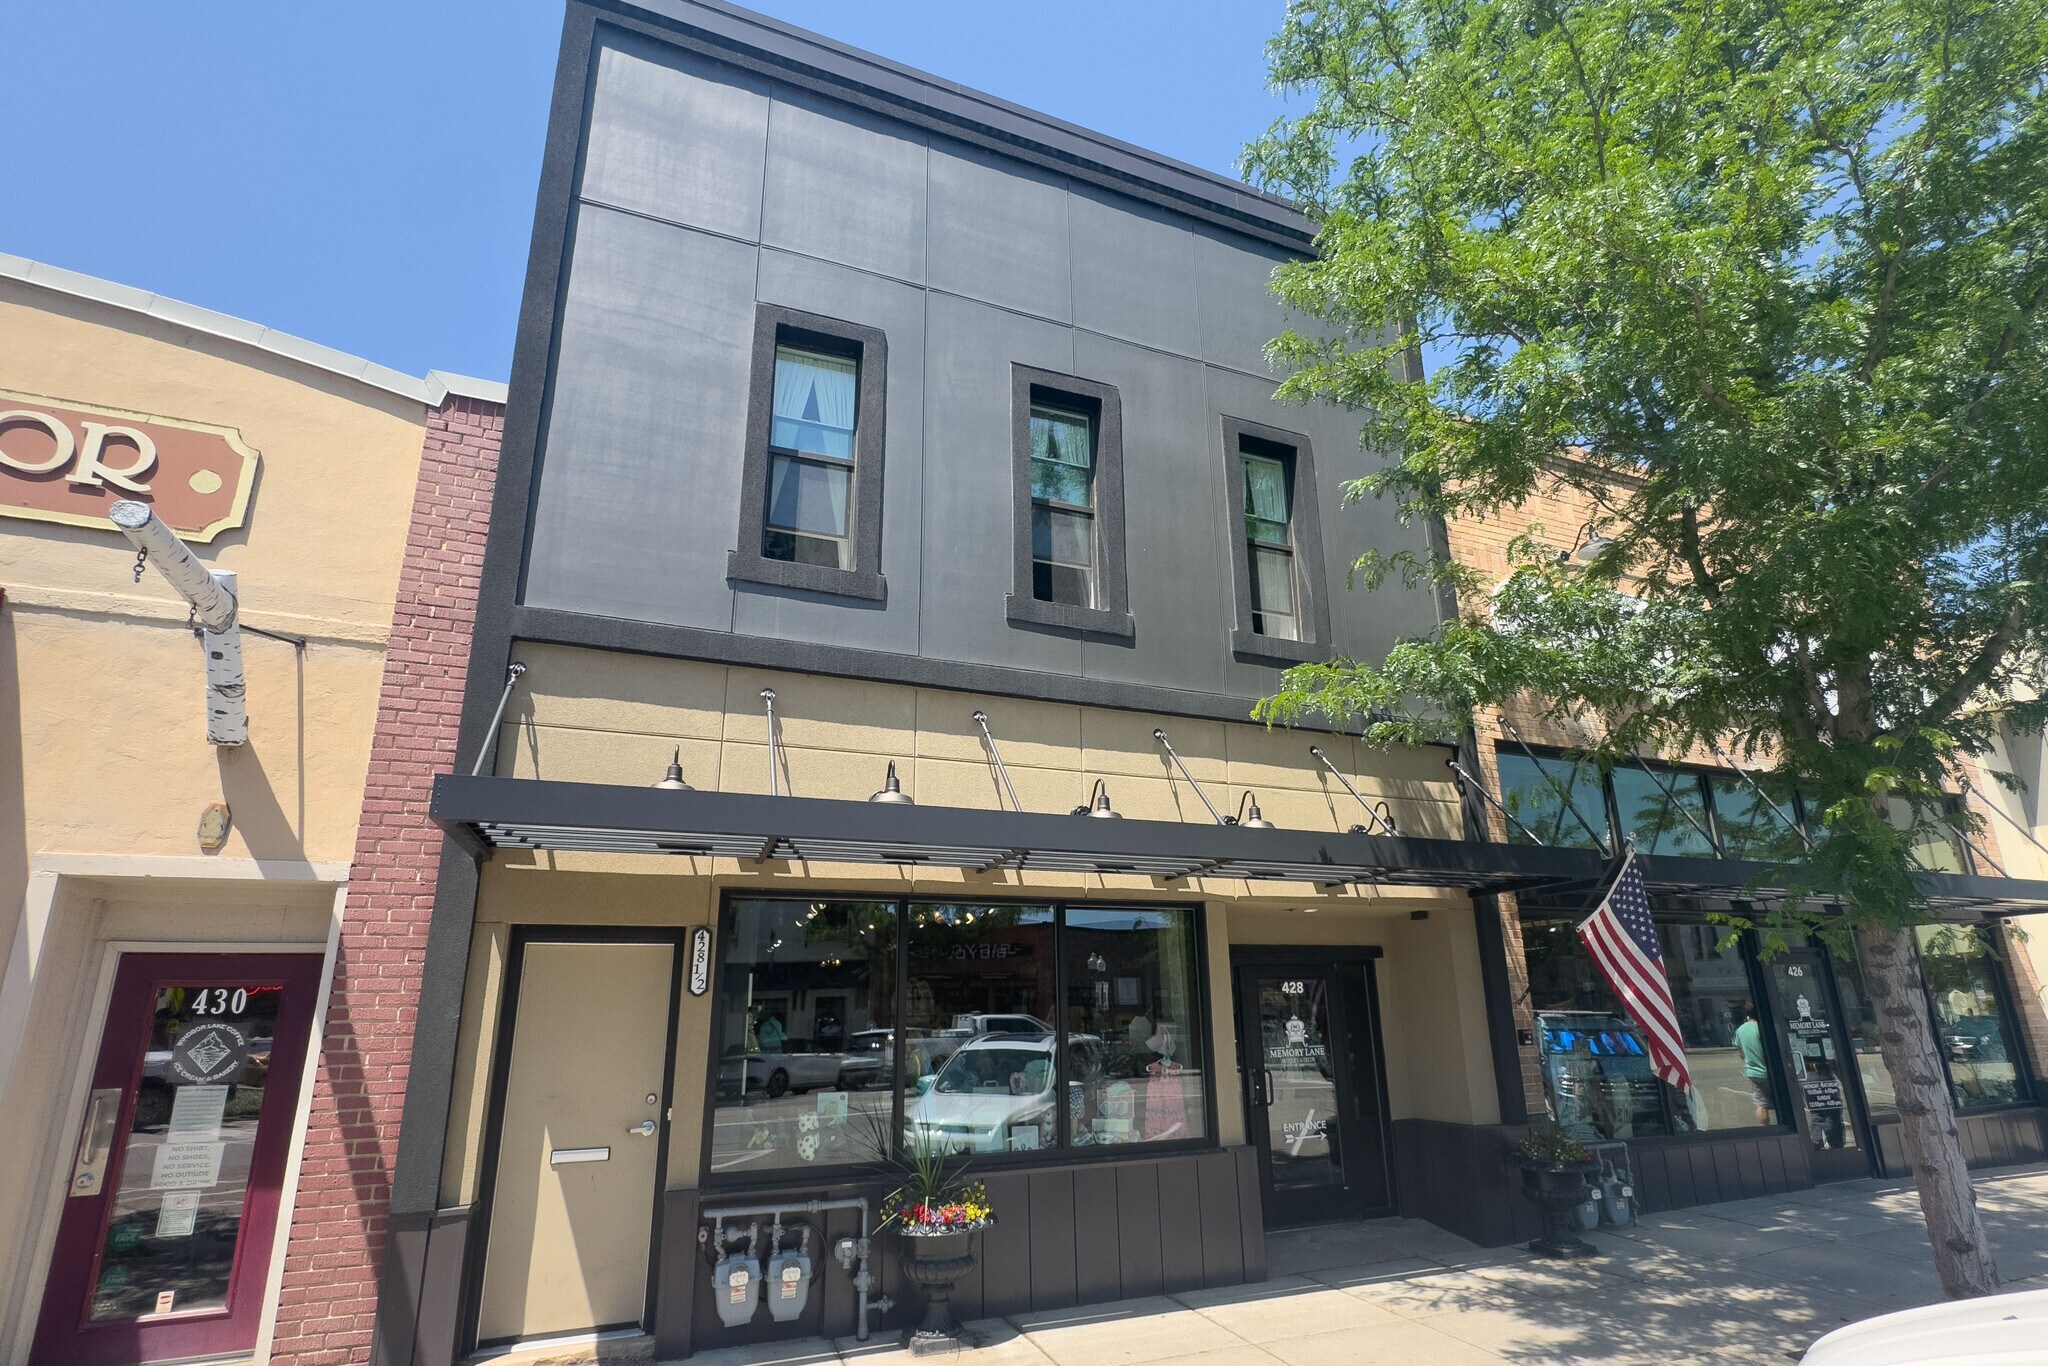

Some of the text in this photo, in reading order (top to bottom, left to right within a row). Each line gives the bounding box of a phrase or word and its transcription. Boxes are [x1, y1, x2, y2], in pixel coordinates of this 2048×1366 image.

[0, 410, 156, 491] OR
[1788, 966, 1803, 977] 426
[1282, 982, 1304, 994] 428
[191, 988, 247, 1015] 430
[1789, 1022, 1812, 1030] MEMORY
[176, 1024, 207, 1047] WINDSOR
[226, 1026, 245, 1047] COFFEE
[1270, 1048, 1325, 1058] MEMORY LANE
[174, 1061, 183, 1073] ICE
[181, 1070, 205, 1082] CREAM
[213, 1060, 239, 1080] BAKERY
[1283, 1120, 1327, 1132] ENTRANCE
[115, 1235, 137, 1243] FAVE
